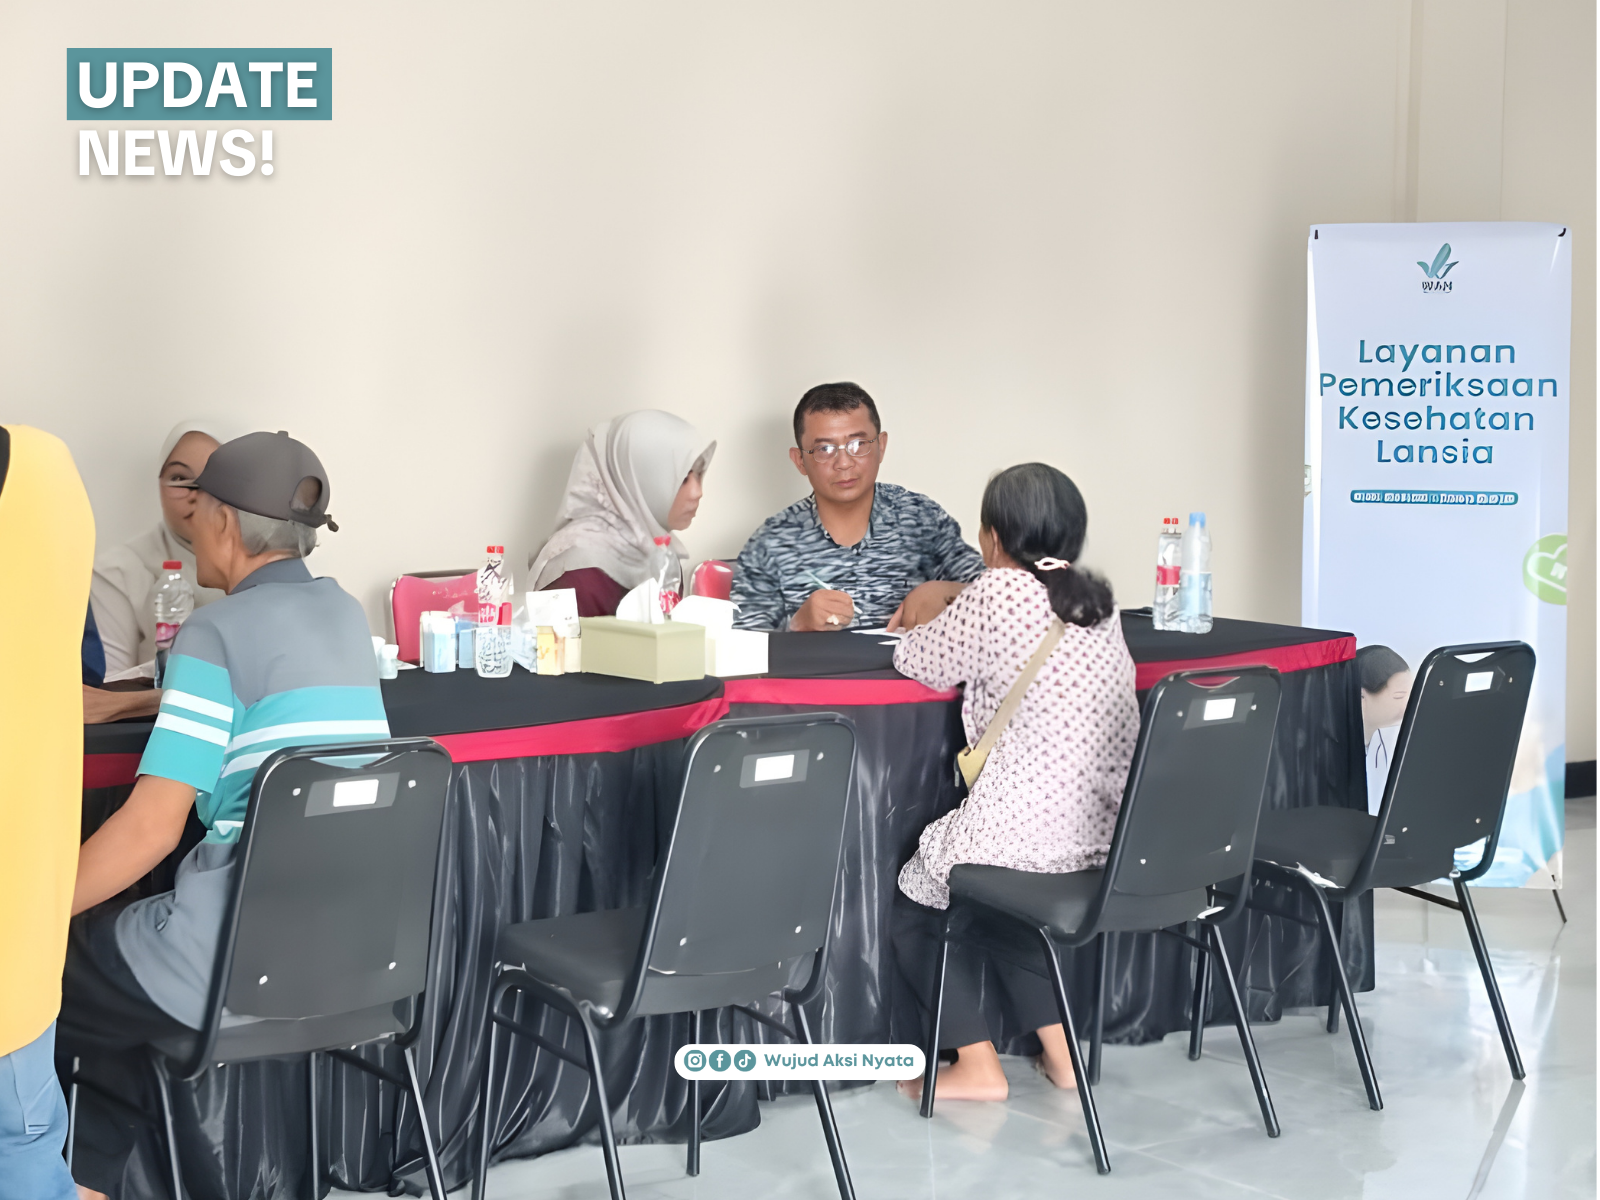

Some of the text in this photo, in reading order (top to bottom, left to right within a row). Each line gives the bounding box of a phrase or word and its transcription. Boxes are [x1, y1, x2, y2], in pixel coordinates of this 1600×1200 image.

[1359, 340, 1516, 372] Layanan
[1319, 371, 1558, 397] Pemeriksaan
[1338, 406, 1534, 431] Kesehatan
[1377, 438, 1493, 464] Lansia
